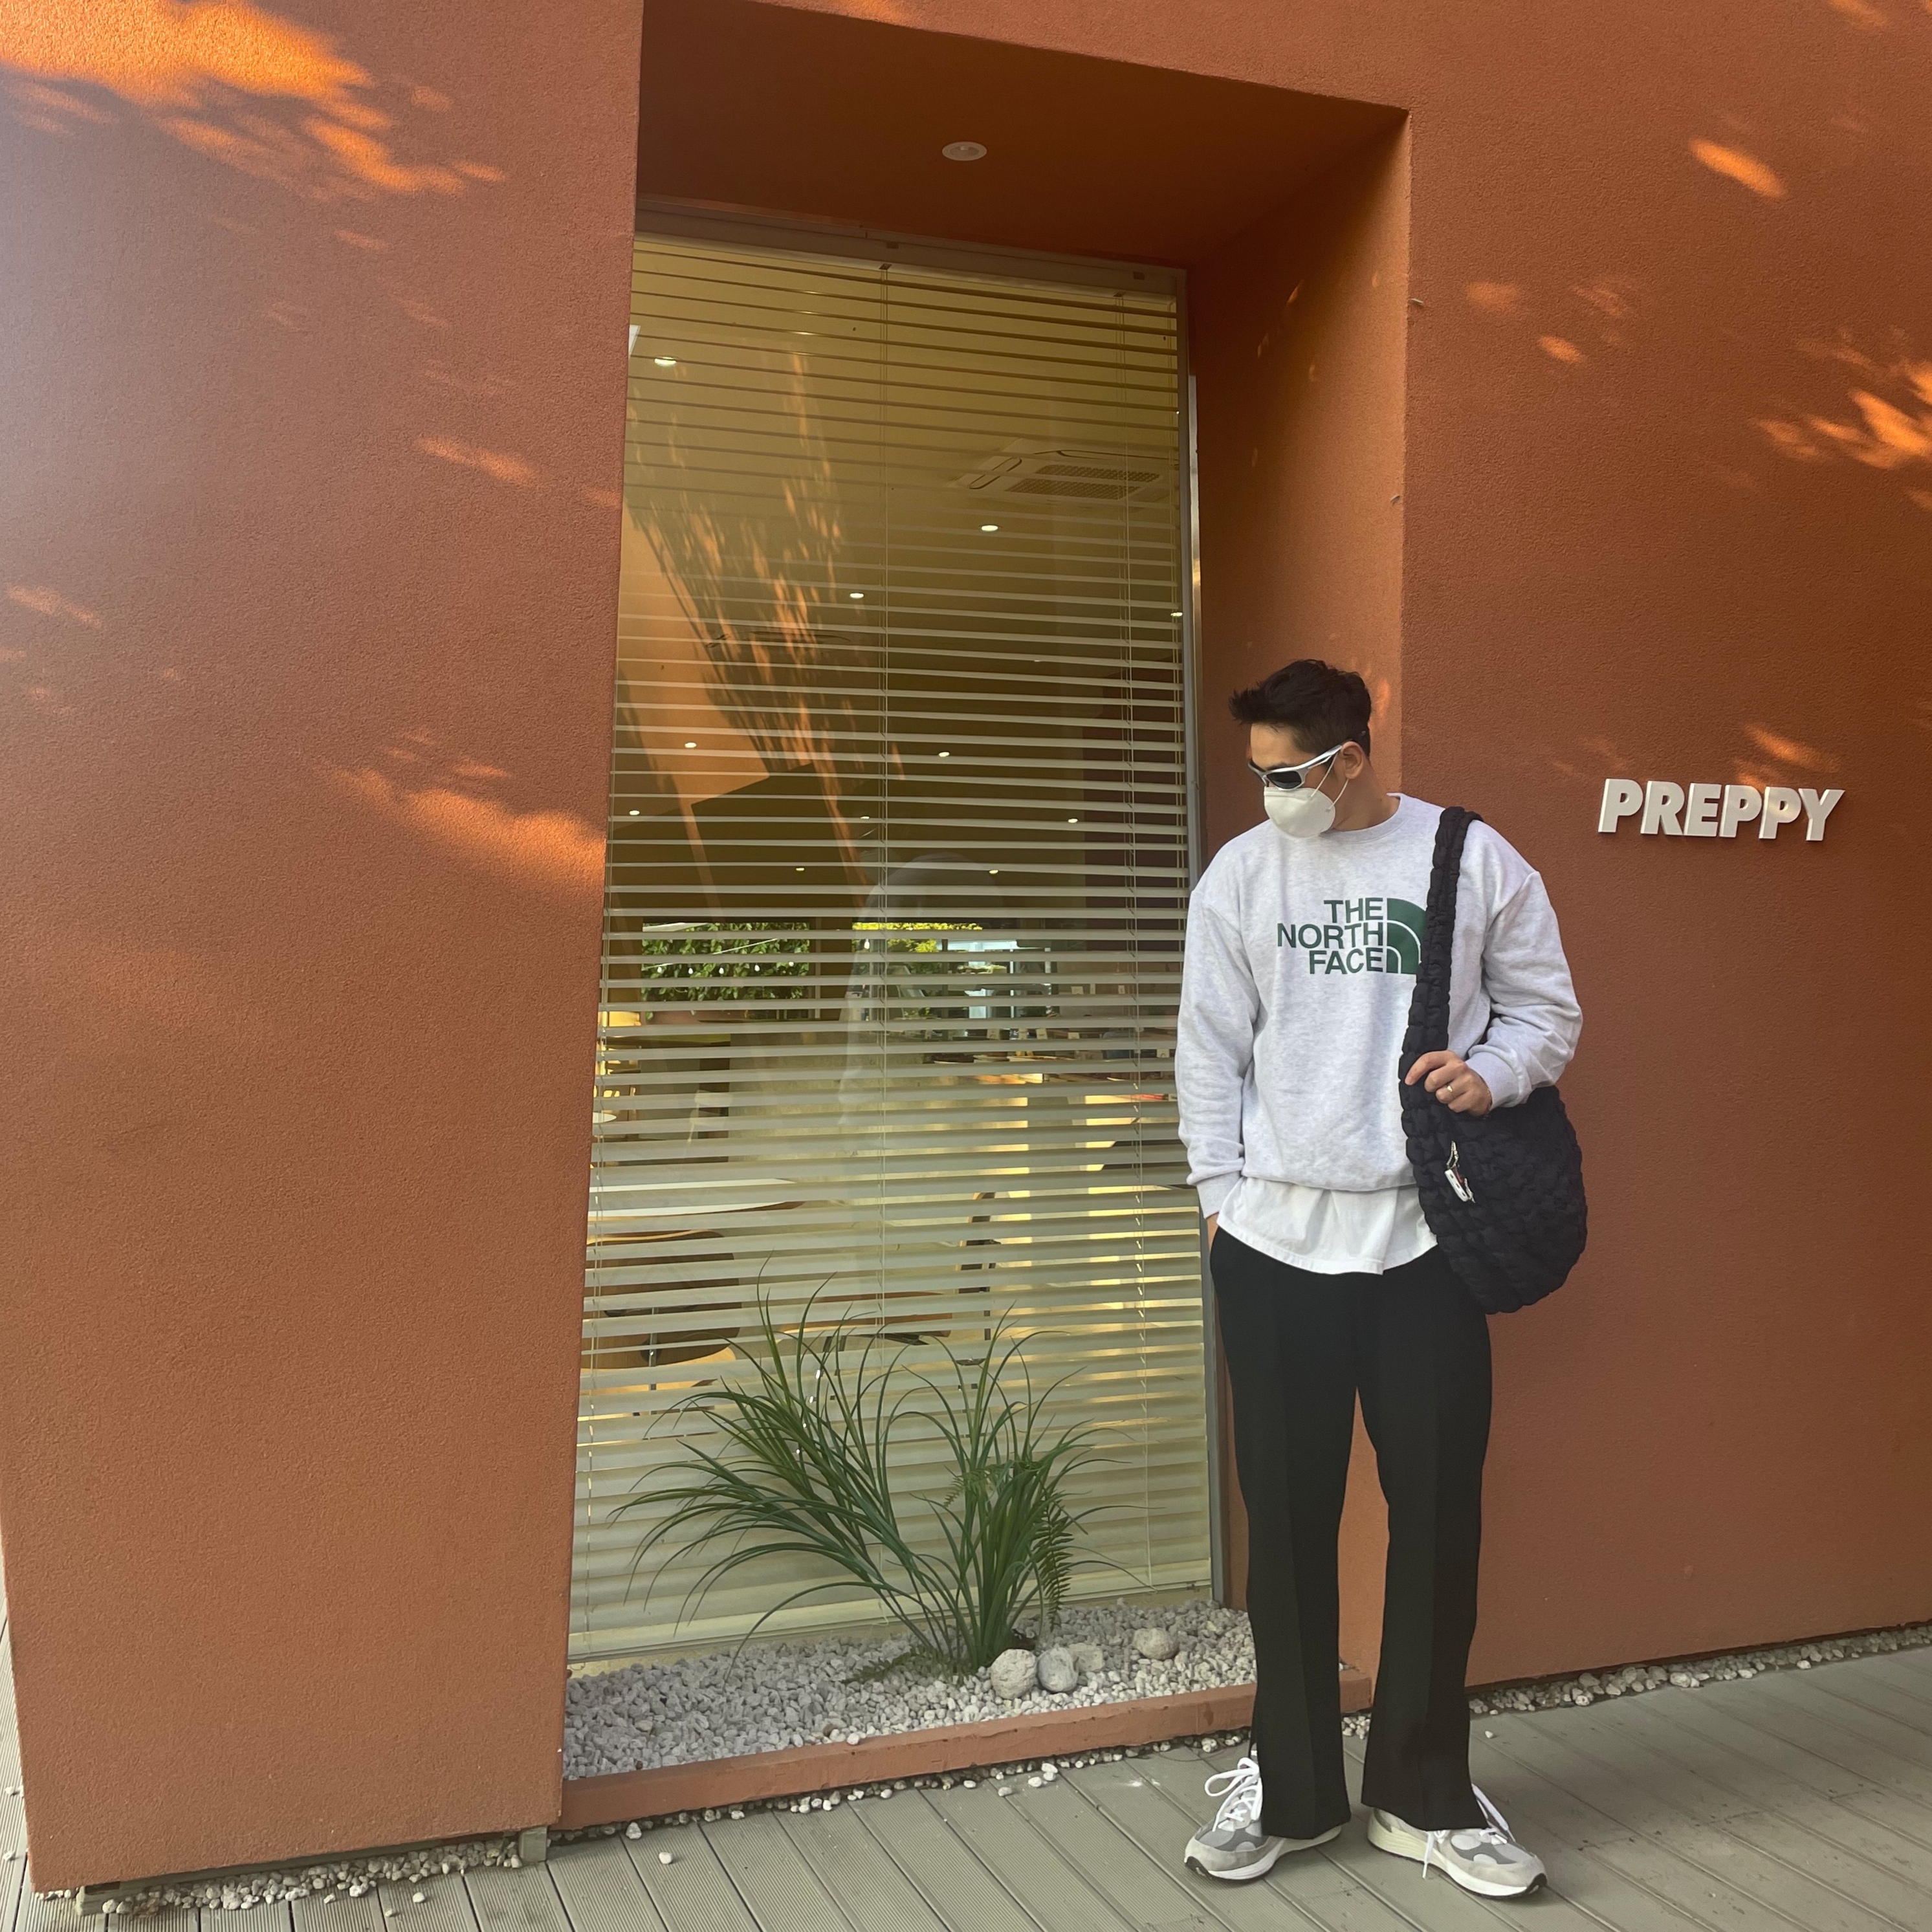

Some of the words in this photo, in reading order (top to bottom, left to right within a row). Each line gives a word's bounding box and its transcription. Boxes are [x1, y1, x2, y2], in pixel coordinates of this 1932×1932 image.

[1598, 778, 1845, 841] PREPPY
[1323, 897, 1383, 923] THE
[1277, 922, 1383, 949] NORTH
[1309, 947, 1383, 974] FACE
